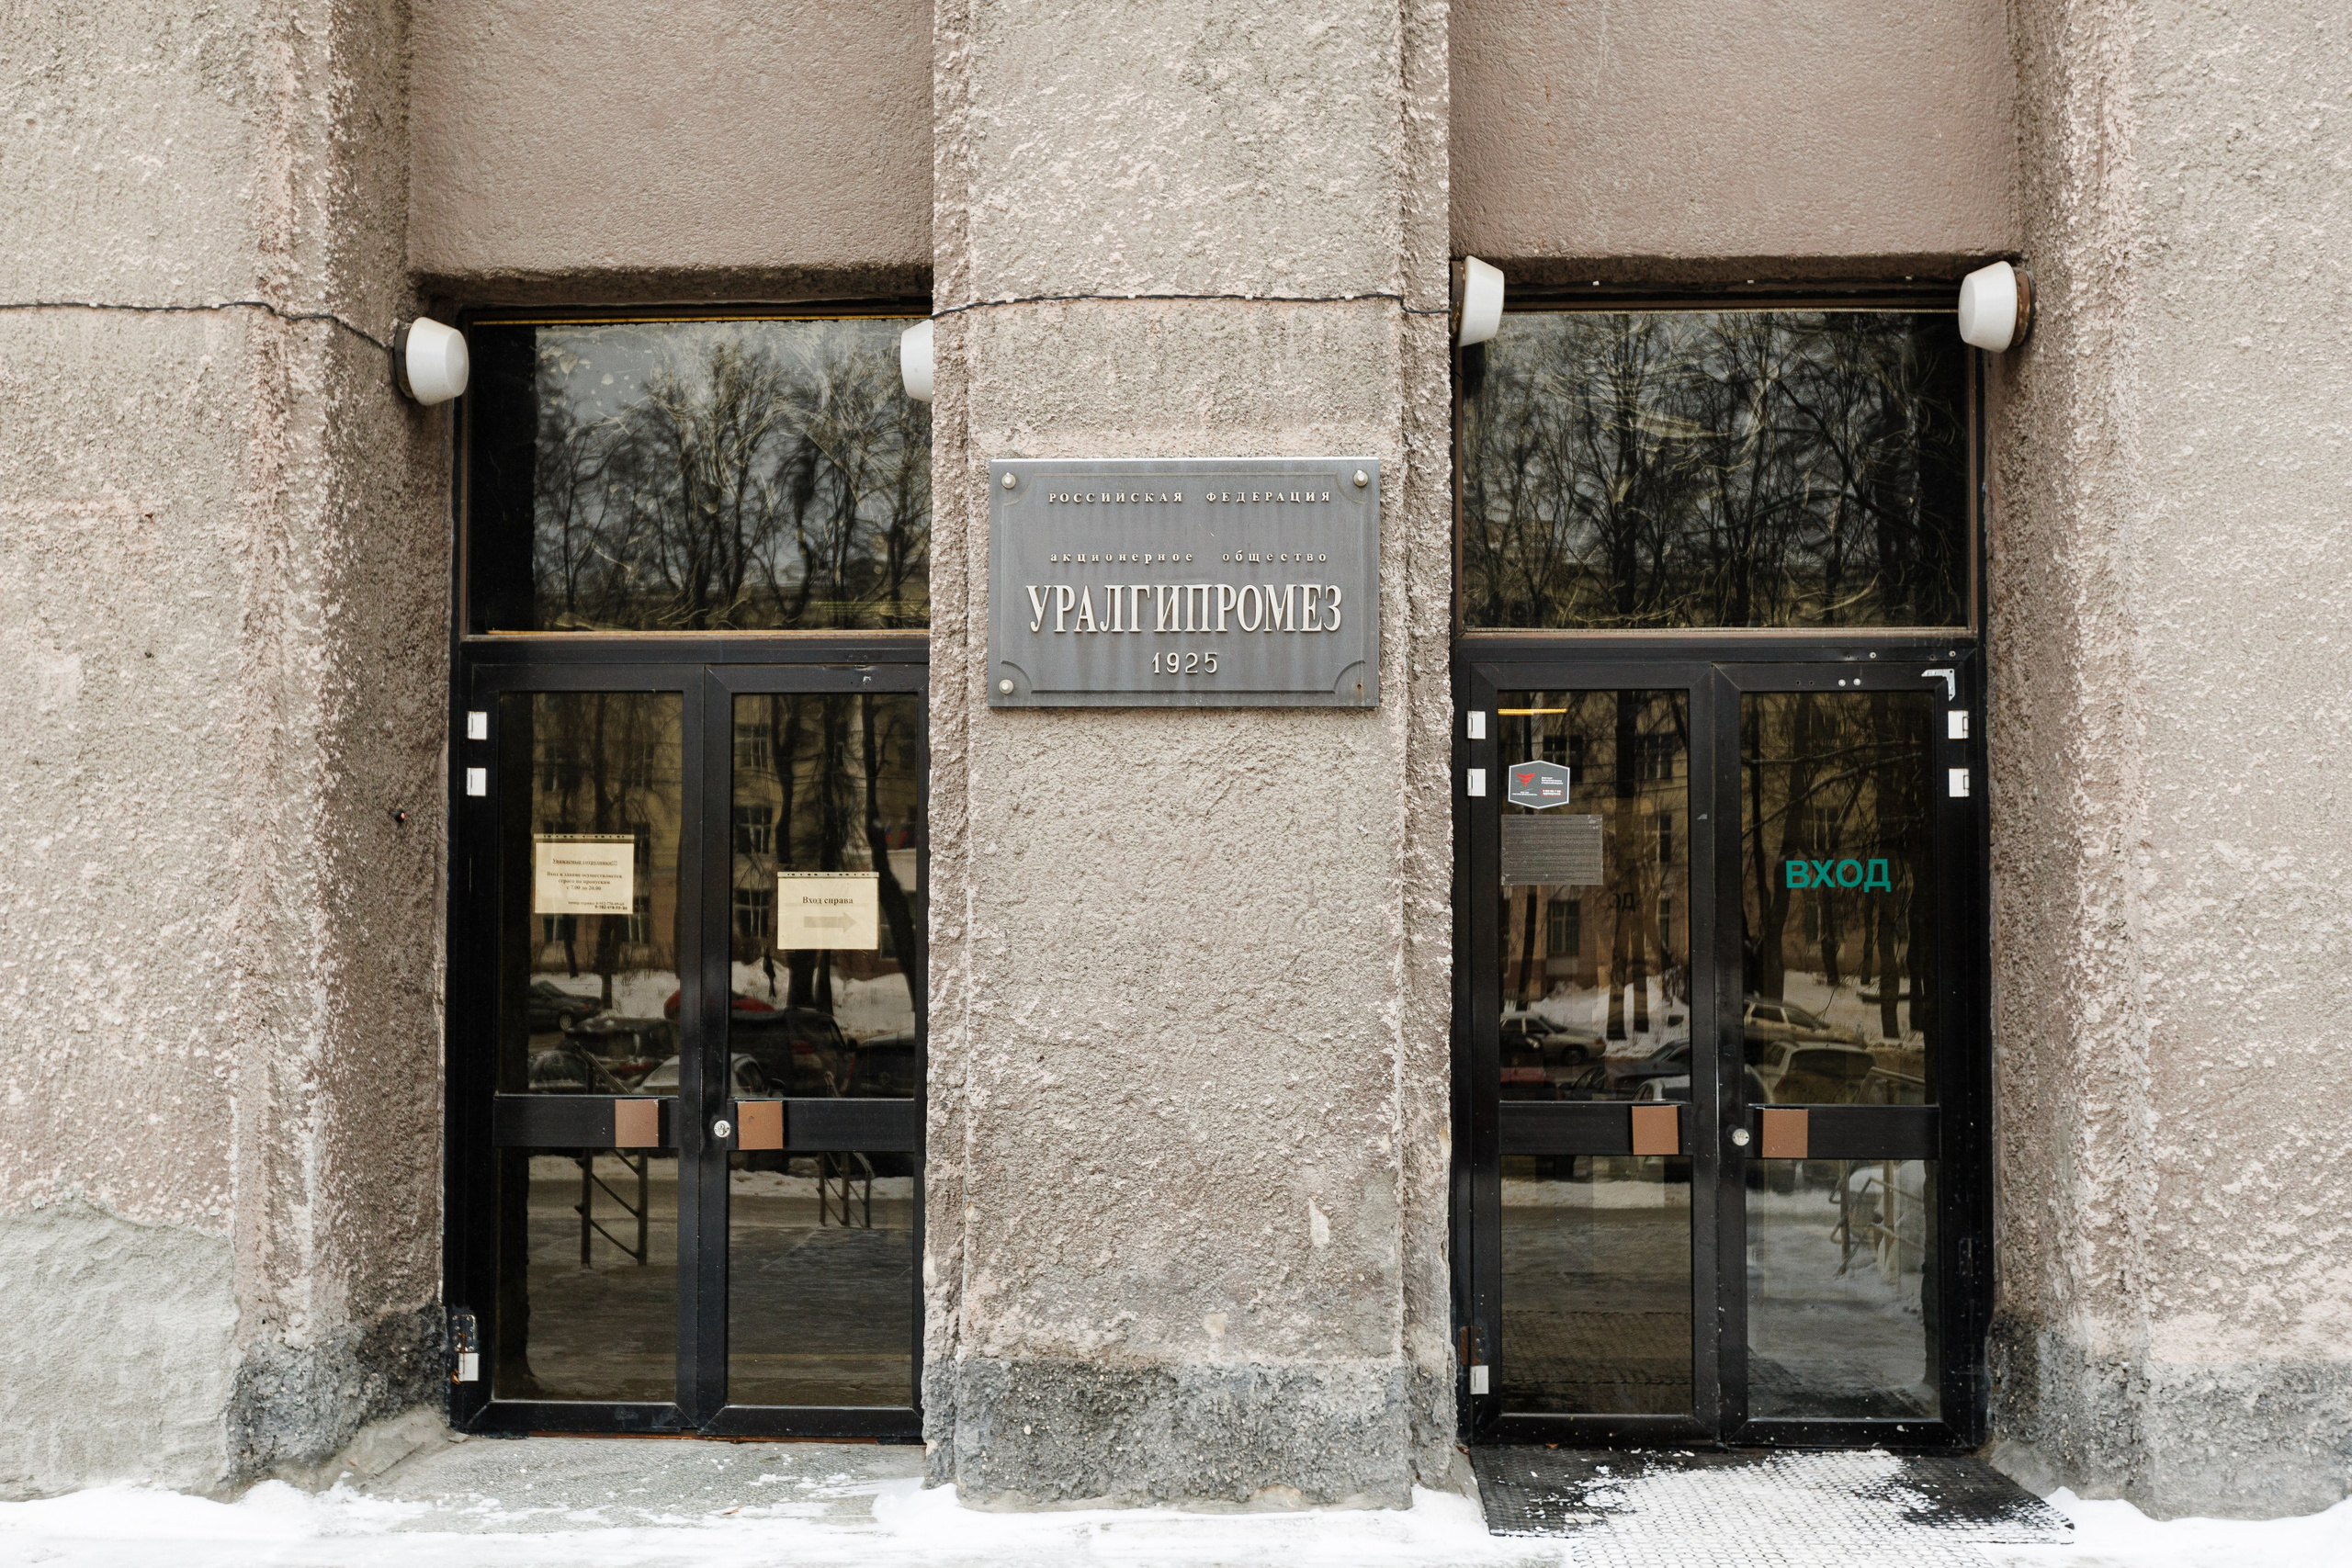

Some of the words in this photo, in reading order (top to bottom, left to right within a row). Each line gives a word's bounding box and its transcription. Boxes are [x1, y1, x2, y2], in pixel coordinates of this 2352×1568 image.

[1206, 491, 1331, 503] ФЕДЕРАЦИЯ
[1050, 552, 1193, 565] акционерное
[1222, 550, 1328, 563] общество
[1026, 584, 1342, 634] УРАЛГИПРОМЕЗ
[1151, 651, 1218, 674] 1925
[1785, 859, 1892, 893] ВХОД
[824, 897, 854, 906] справа
